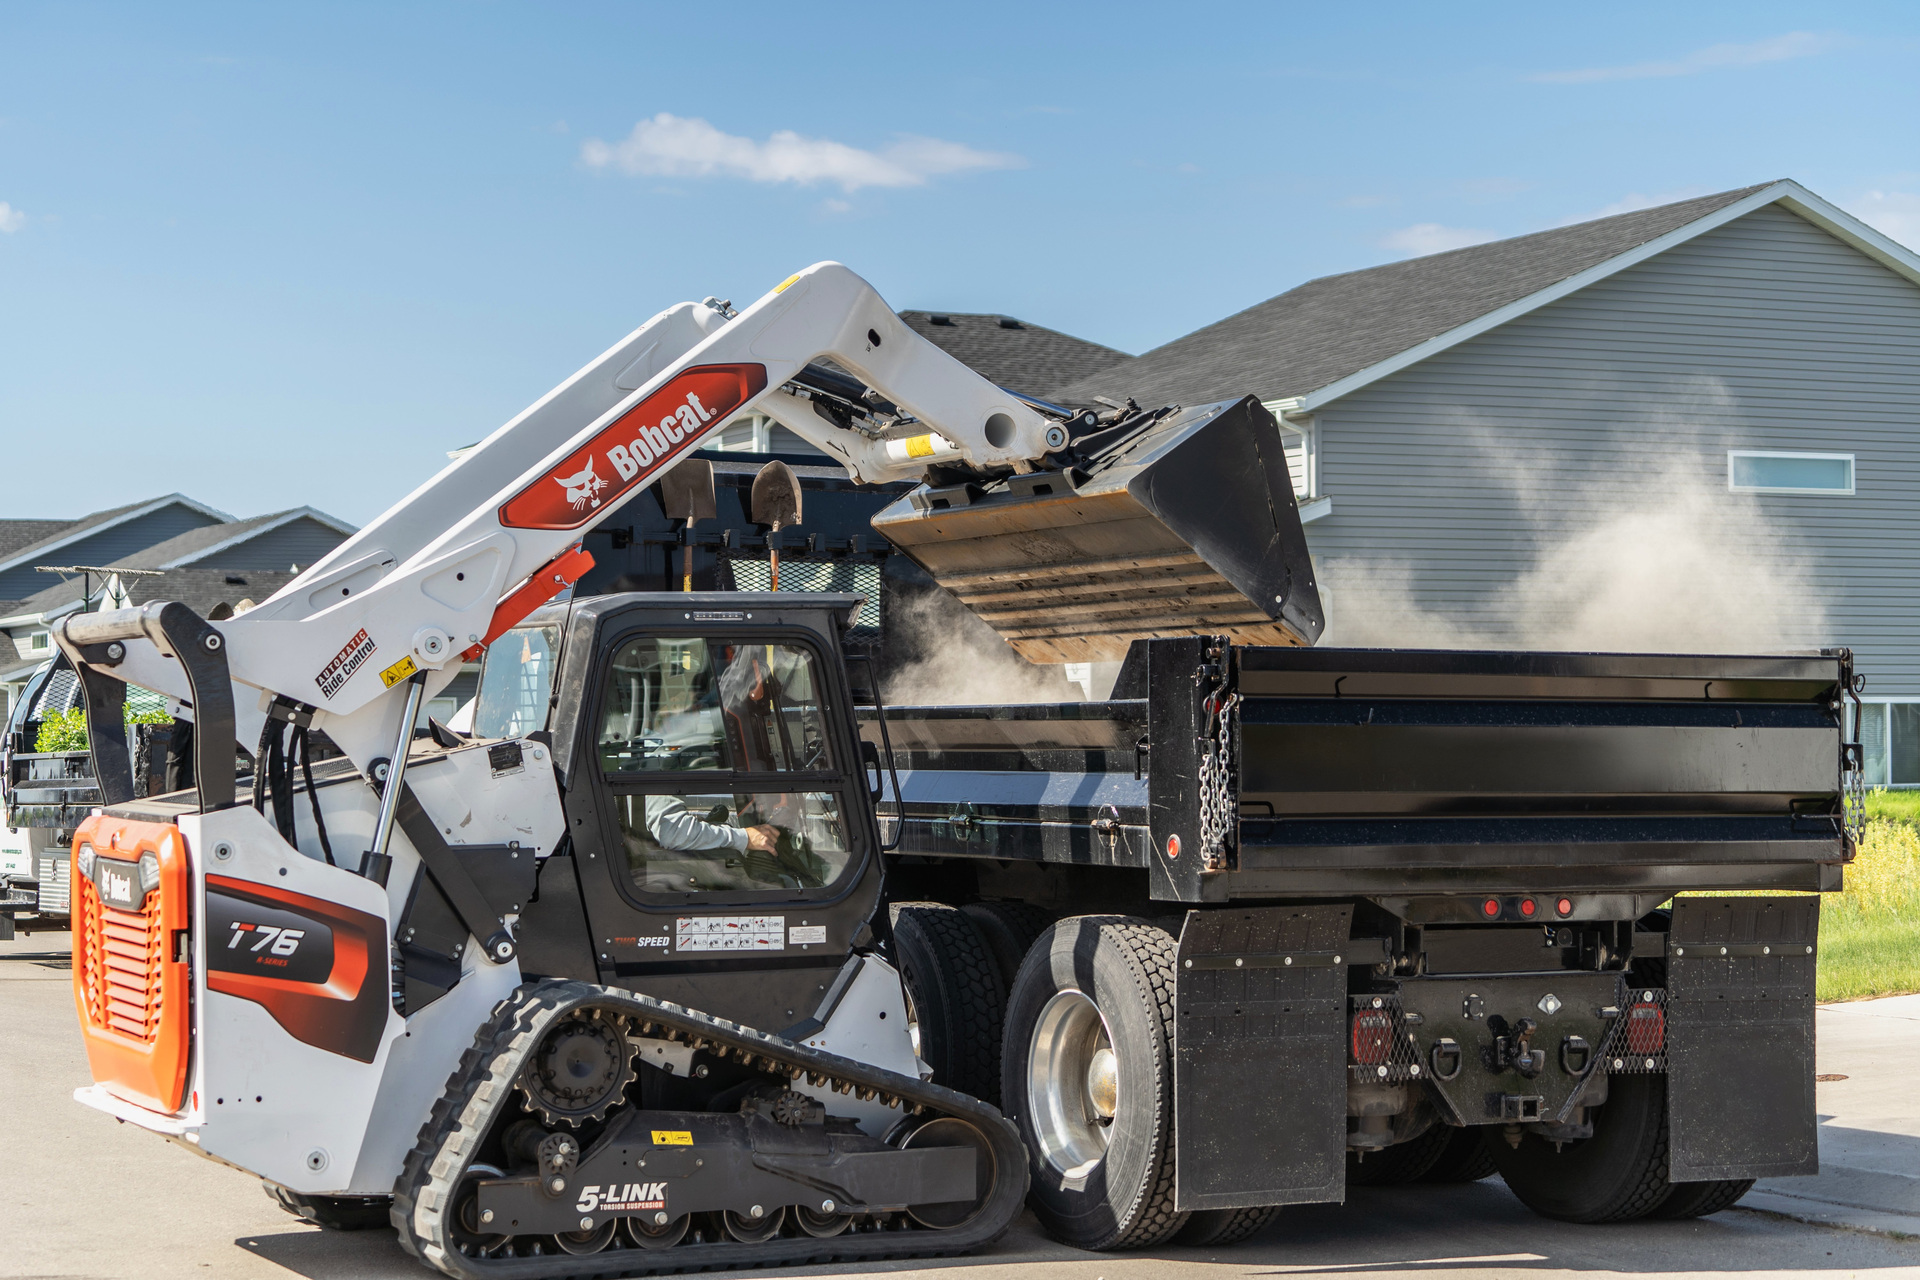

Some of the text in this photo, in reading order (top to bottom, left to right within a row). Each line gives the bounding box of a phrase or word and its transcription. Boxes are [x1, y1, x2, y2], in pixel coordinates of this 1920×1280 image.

[318, 631, 366, 687] AUTOMATIC
[321, 637, 376, 698] Ride Control
[227, 922, 305, 956] T76
[614, 936, 670, 947] TWO SPEED
[576, 1182, 668, 1213] 5-LINK
[600, 1201, 663, 1211] TORSION SUSPENSION
